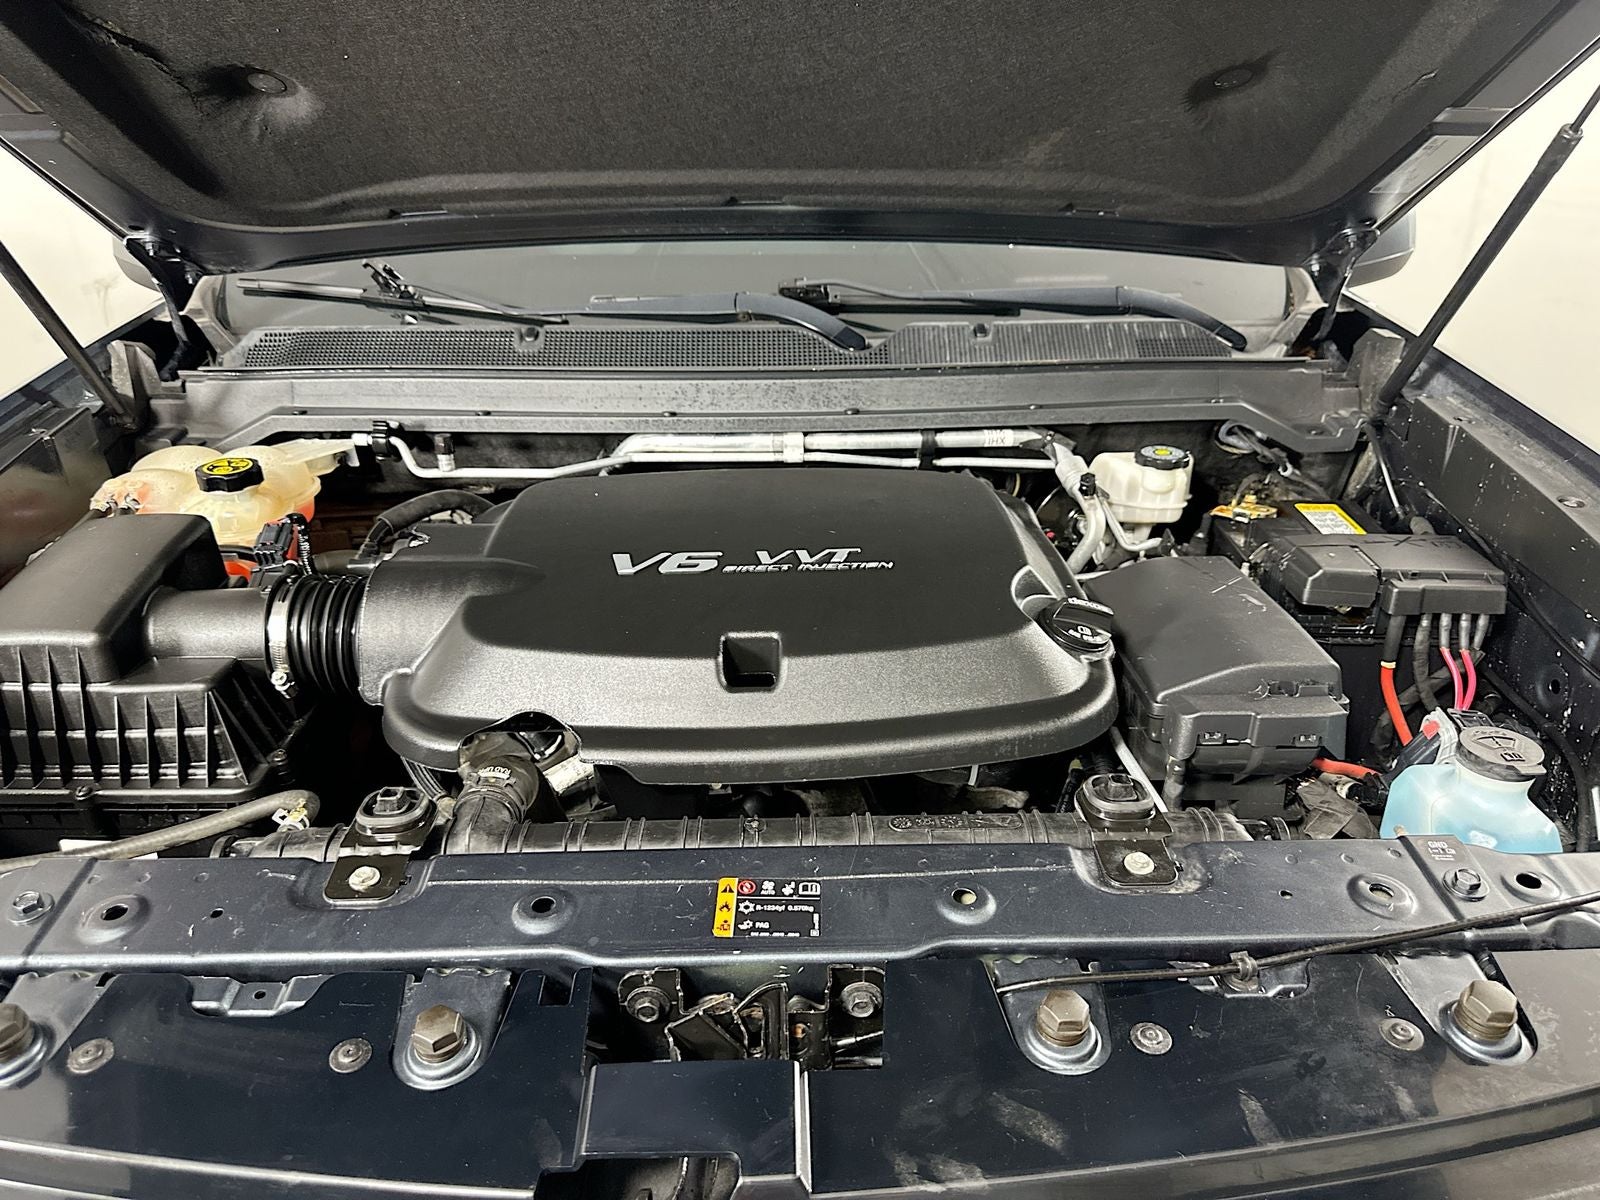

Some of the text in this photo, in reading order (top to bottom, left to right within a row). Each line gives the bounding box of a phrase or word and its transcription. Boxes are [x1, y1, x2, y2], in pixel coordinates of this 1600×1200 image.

[612, 551, 723, 575] V6
[756, 547, 862, 565] VVT
[722, 561, 894, 573] DIRECT INJECTION
[494, 766, 512, 775] RAD
